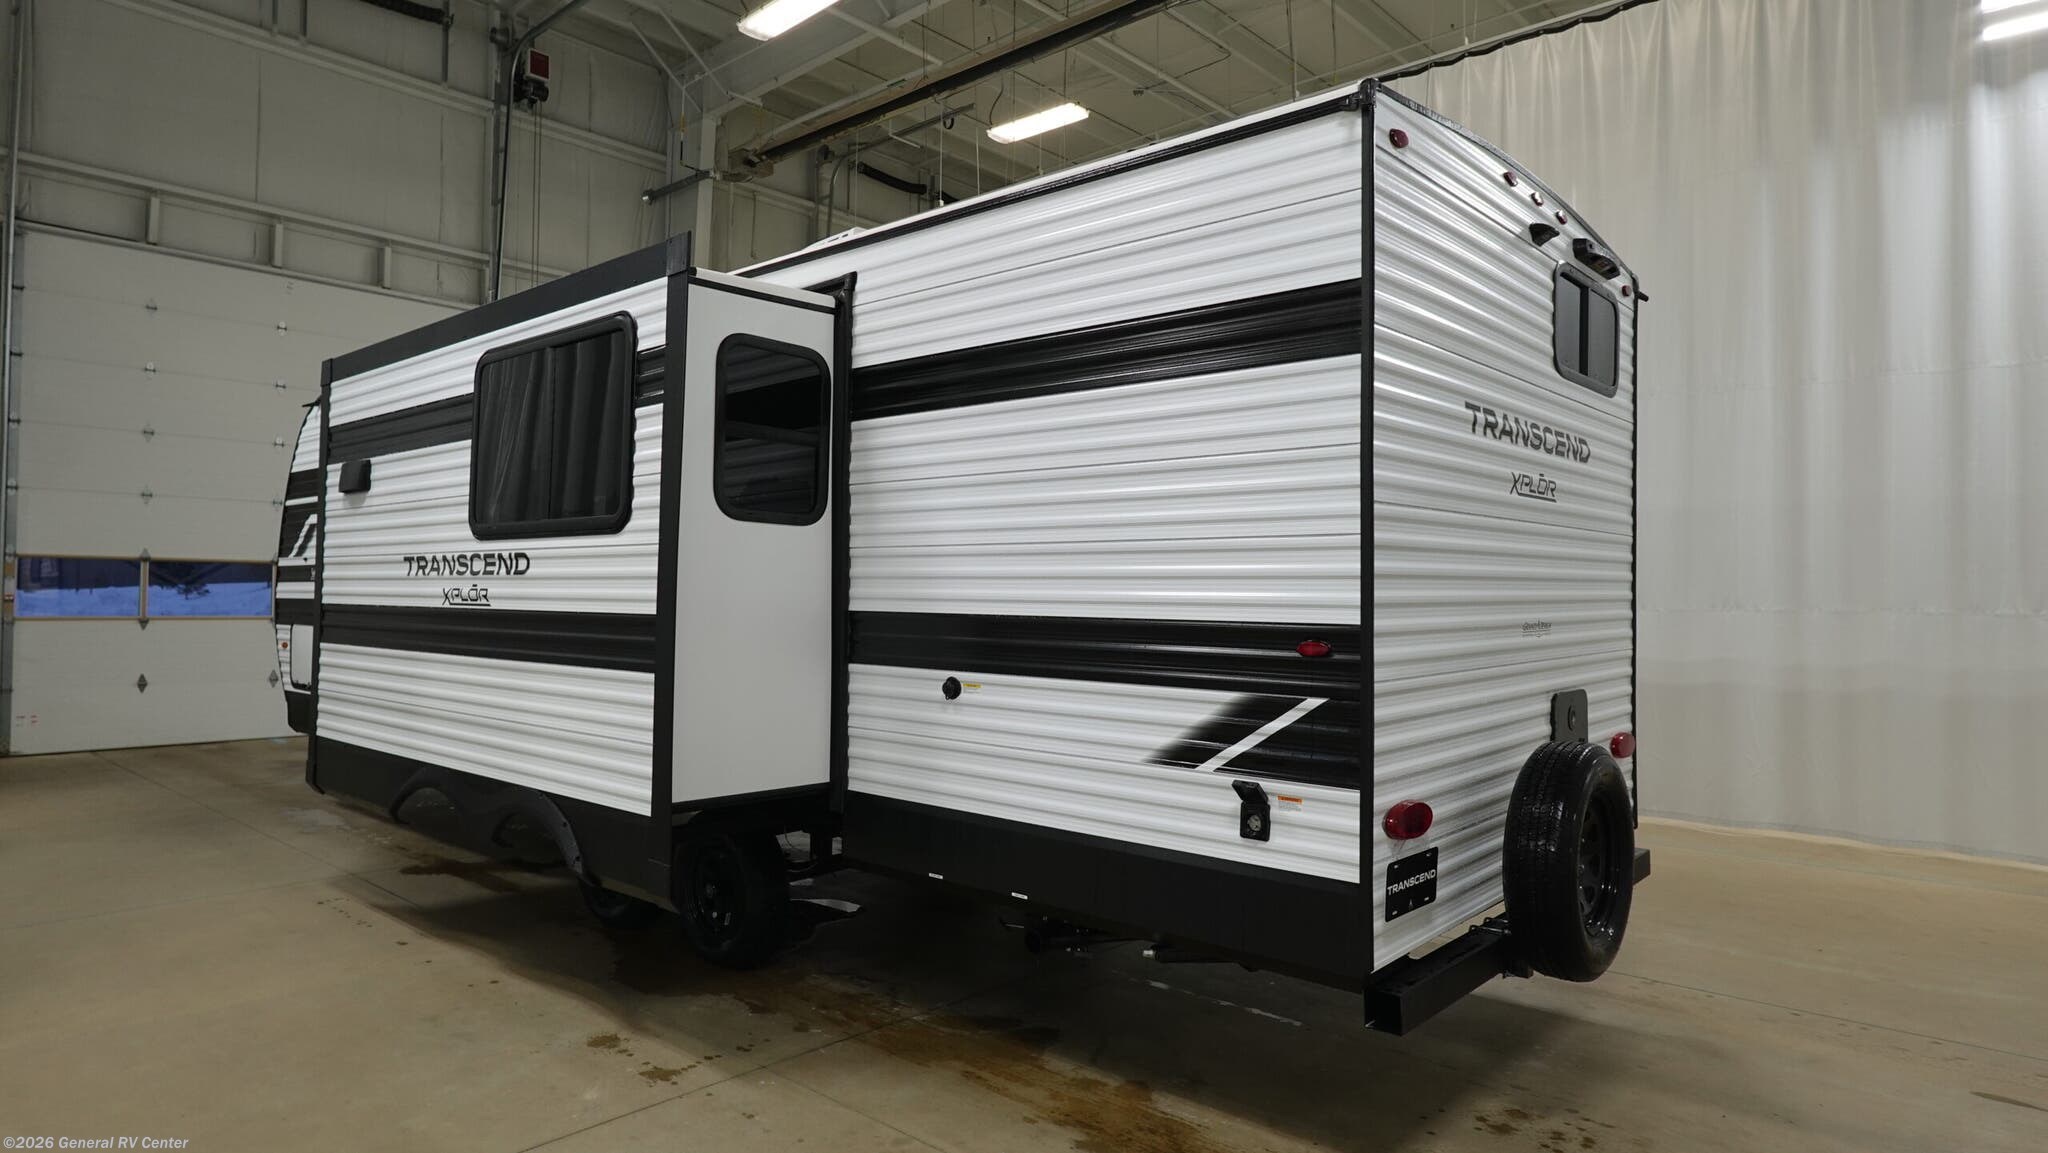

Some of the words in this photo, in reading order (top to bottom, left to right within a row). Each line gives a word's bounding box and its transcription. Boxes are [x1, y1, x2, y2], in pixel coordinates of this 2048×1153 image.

[1464, 401, 1591, 463] TRANSCEND
[403, 552, 530, 576] TRANSCEND
[1387, 869, 1436, 896] TRANSCEND
